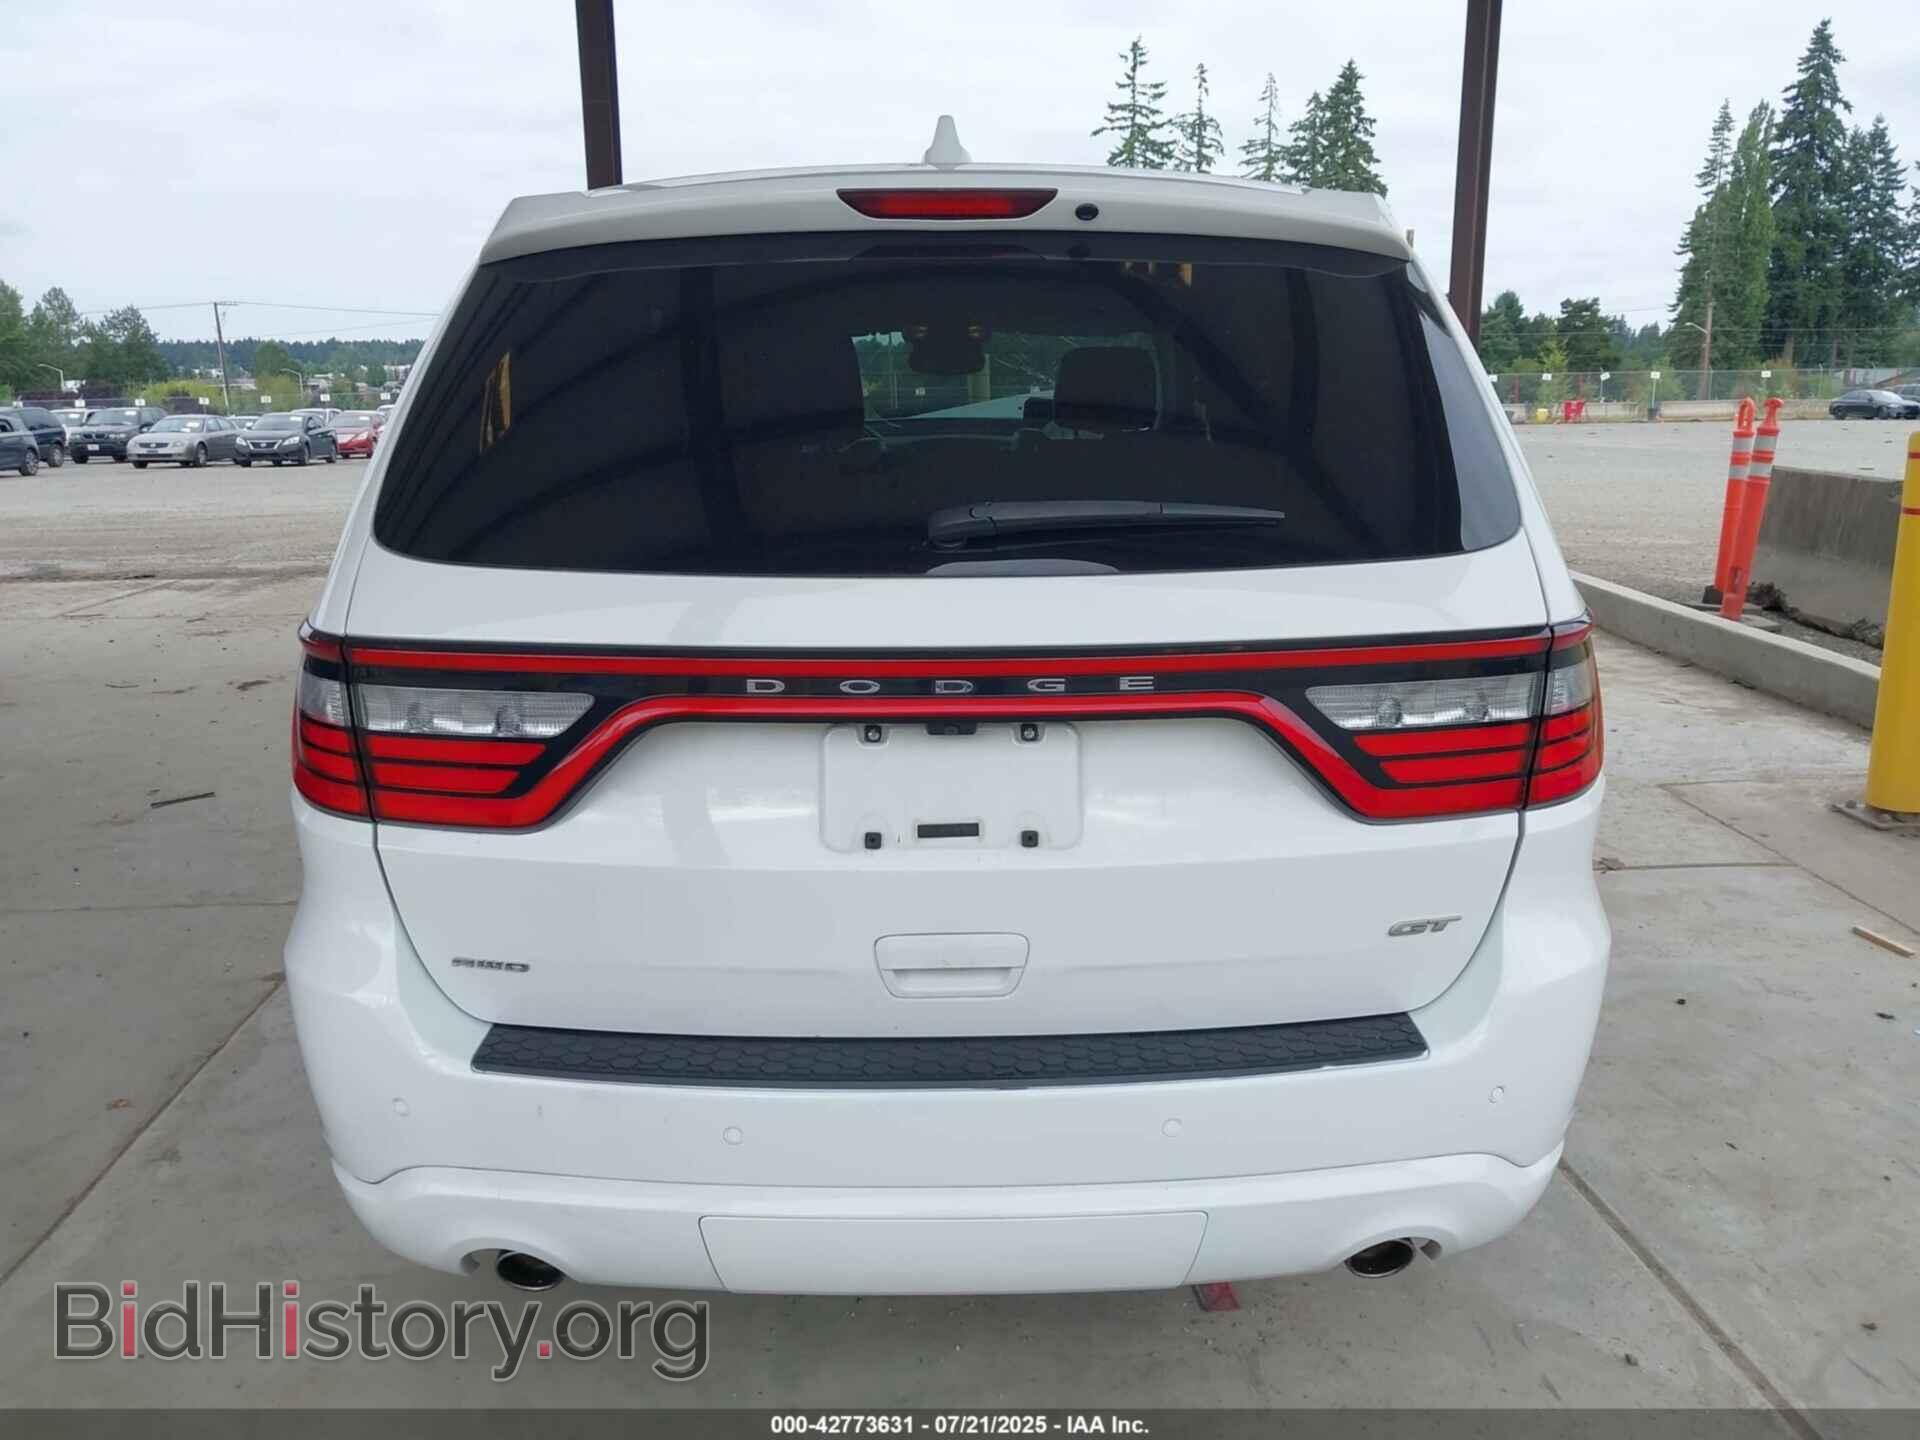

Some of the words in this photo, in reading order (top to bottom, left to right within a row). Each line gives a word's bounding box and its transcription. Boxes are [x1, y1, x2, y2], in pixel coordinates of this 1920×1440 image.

[746, 675, 1155, 694] DODGE
[1387, 915, 1463, 937] GT
[451, 957, 530, 973] AWD
